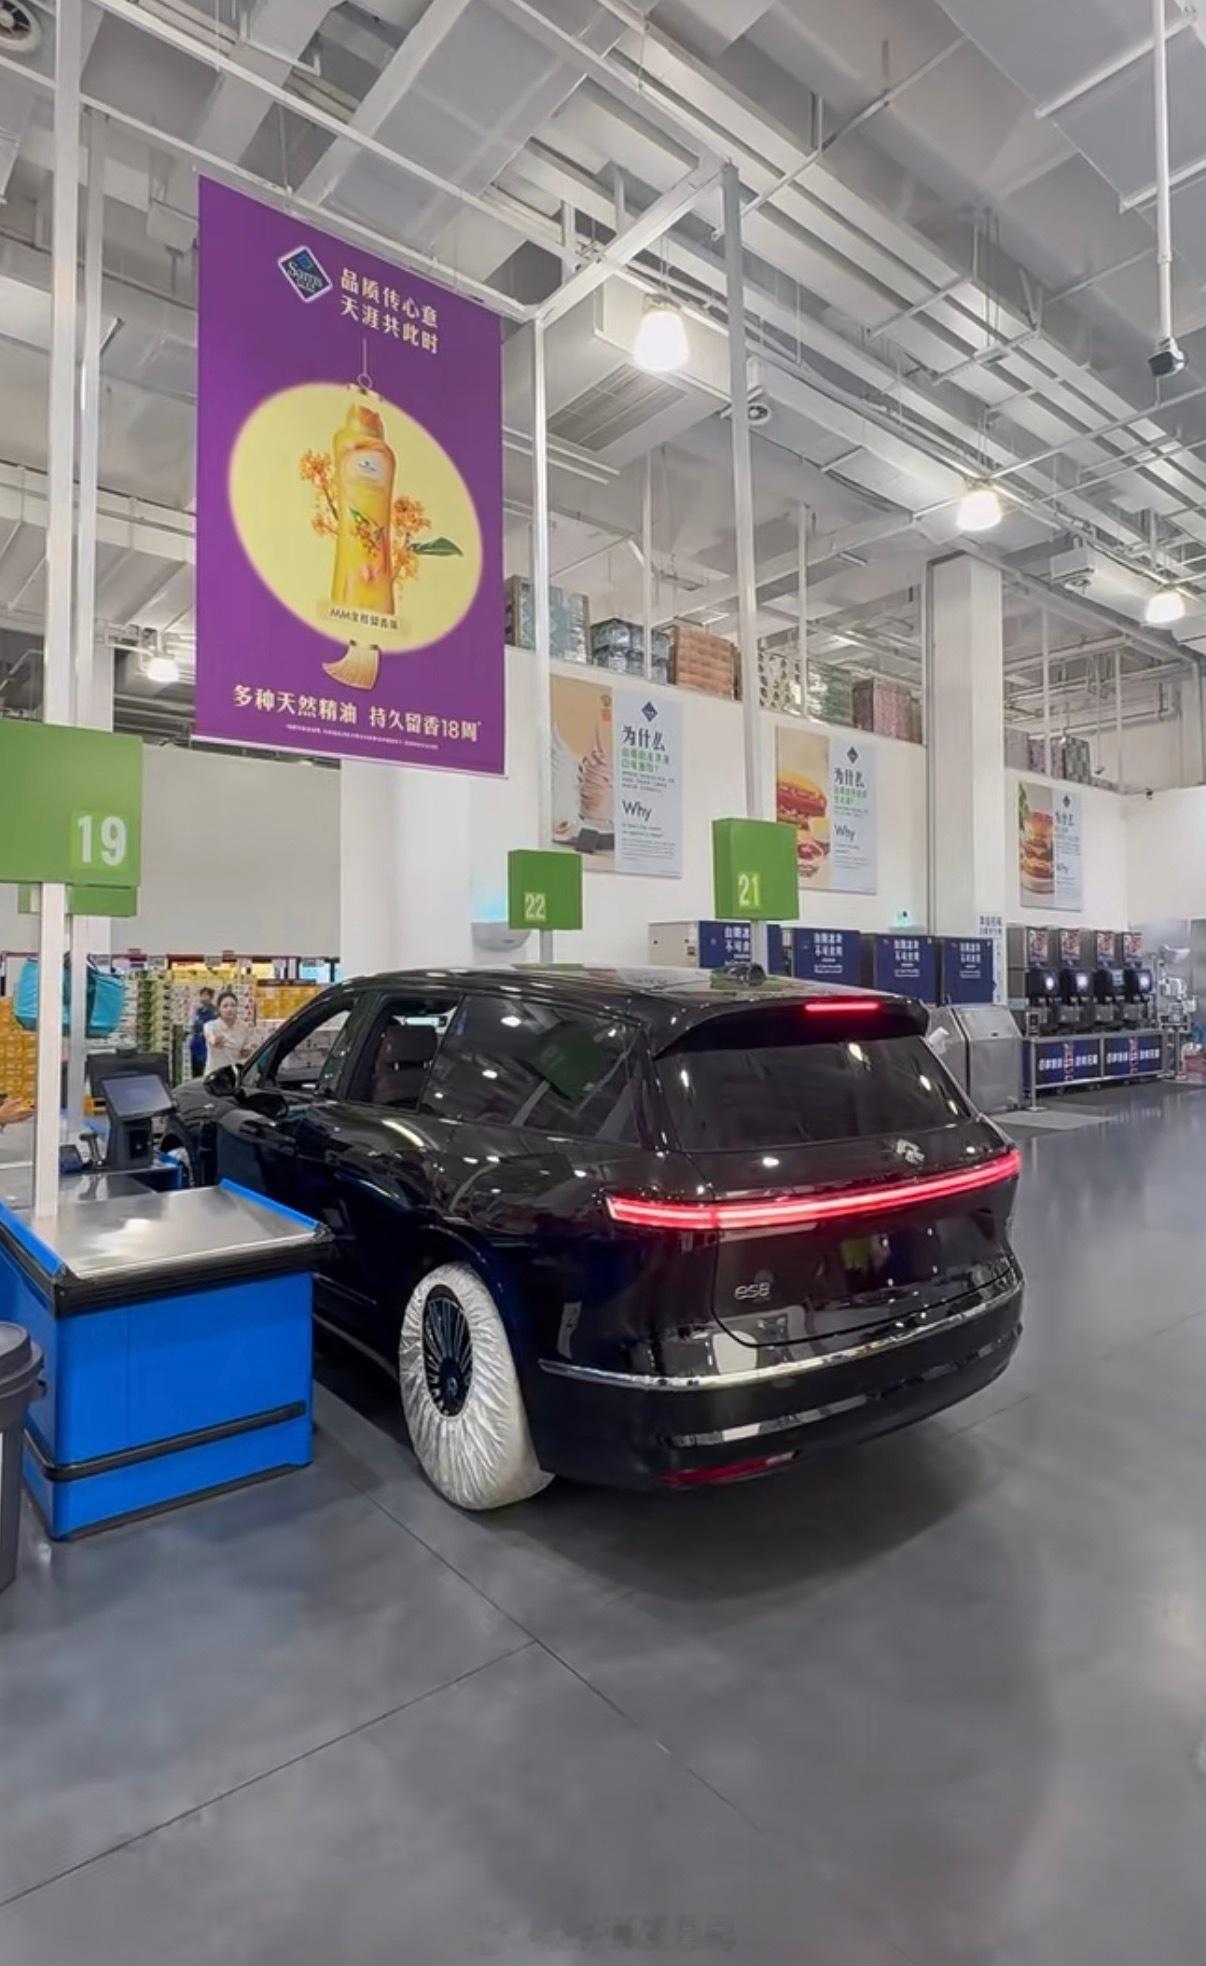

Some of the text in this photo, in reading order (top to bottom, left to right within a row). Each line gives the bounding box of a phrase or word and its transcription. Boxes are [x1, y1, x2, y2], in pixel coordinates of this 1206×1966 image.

[341, 267, 439, 329] 品质传心意
[340, 293, 439, 354] 天涯共此时
[233, 684, 358, 725] 多种天然精油
[622, 724, 666, 752] 为什么
[621, 799, 652, 822] Why
[77, 814, 128, 867] 19
[524, 893, 547, 920] 22
[737, 873, 761, 908] 21
